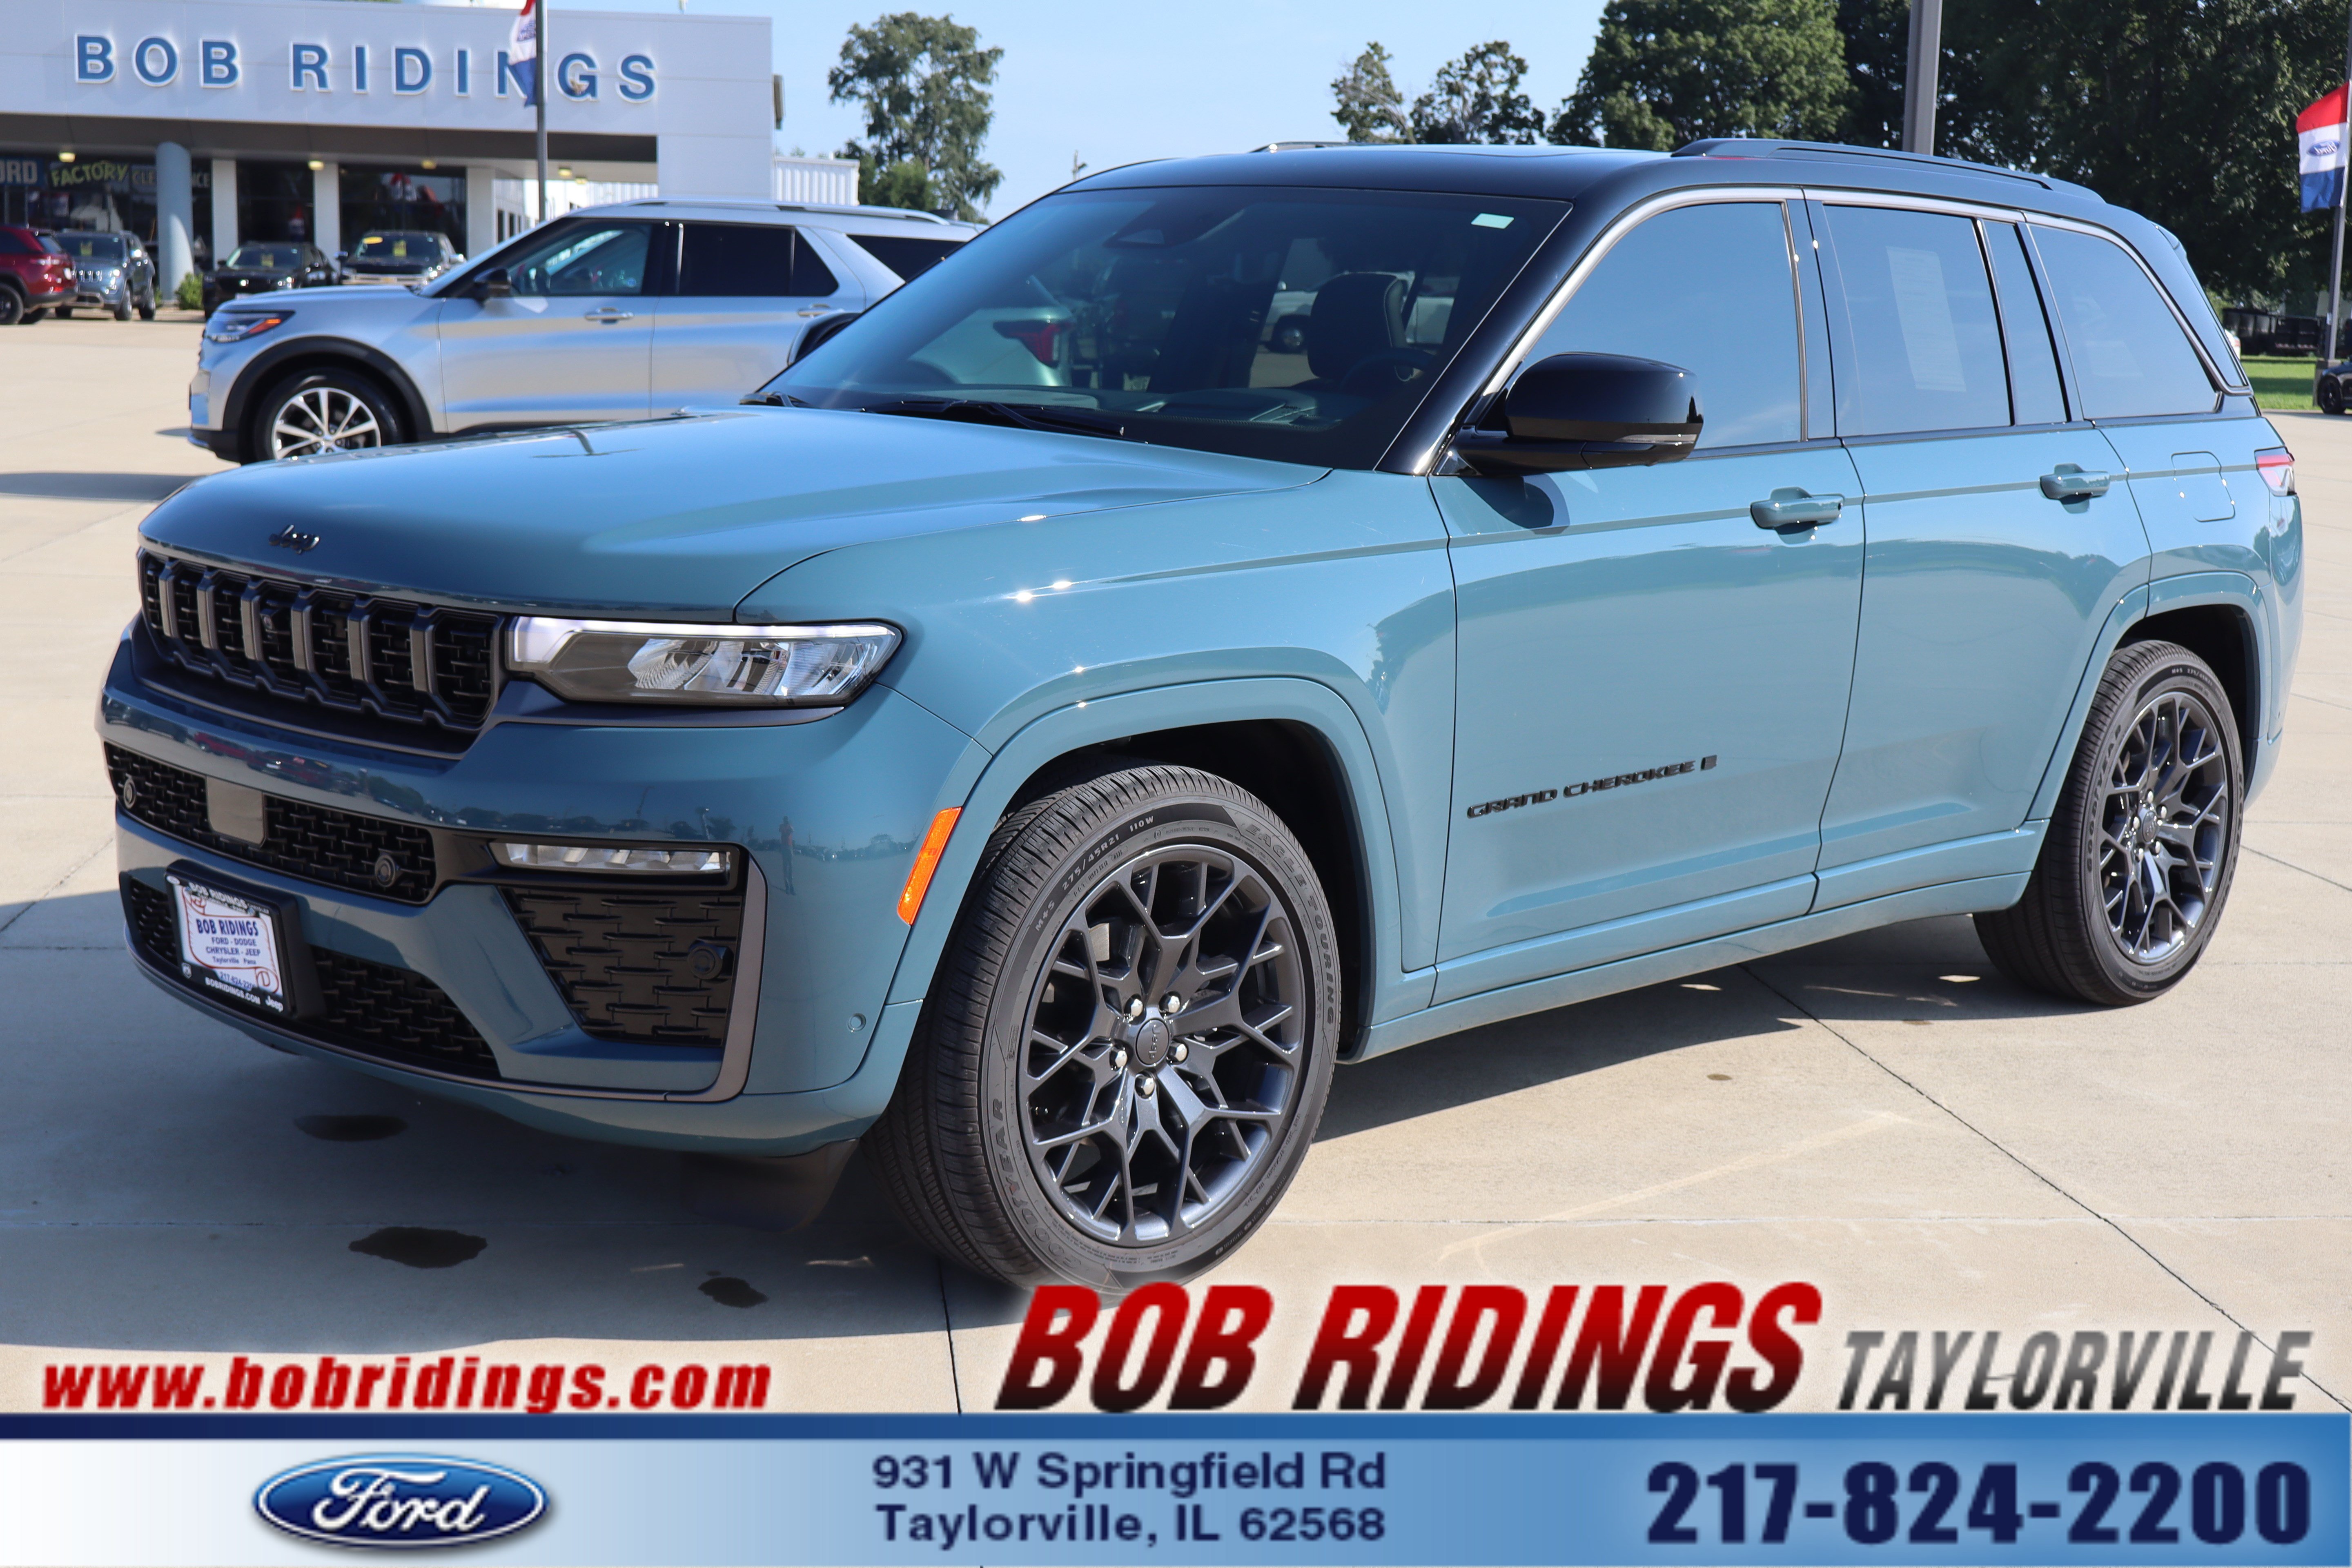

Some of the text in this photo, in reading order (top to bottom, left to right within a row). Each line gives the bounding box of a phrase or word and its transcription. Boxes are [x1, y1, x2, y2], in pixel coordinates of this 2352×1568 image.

[76, 33, 657, 103] BOB RIDINGS
[51, 162, 129, 187] FACTORY
[1467, 760, 1696, 819] GRAND CHEROKEE
[1062, 833, 1120, 891] 275/45R21
[1129, 815, 1154, 833] 110W
[209, 889, 248, 910] RIDINGS
[196, 918, 259, 936] BOB RIDINGS
[1245, 824, 1308, 888] EAGLE
[1307, 895, 1334, 1025] TOURING
[206, 946, 240, 956] CHRYSLER
[211, 937, 229, 945] FORD
[234, 938, 257, 946] DODGE
[205, 976, 261, 1005] BOBRIDINGS.COM
[265, 995, 284, 1013] Jeep
